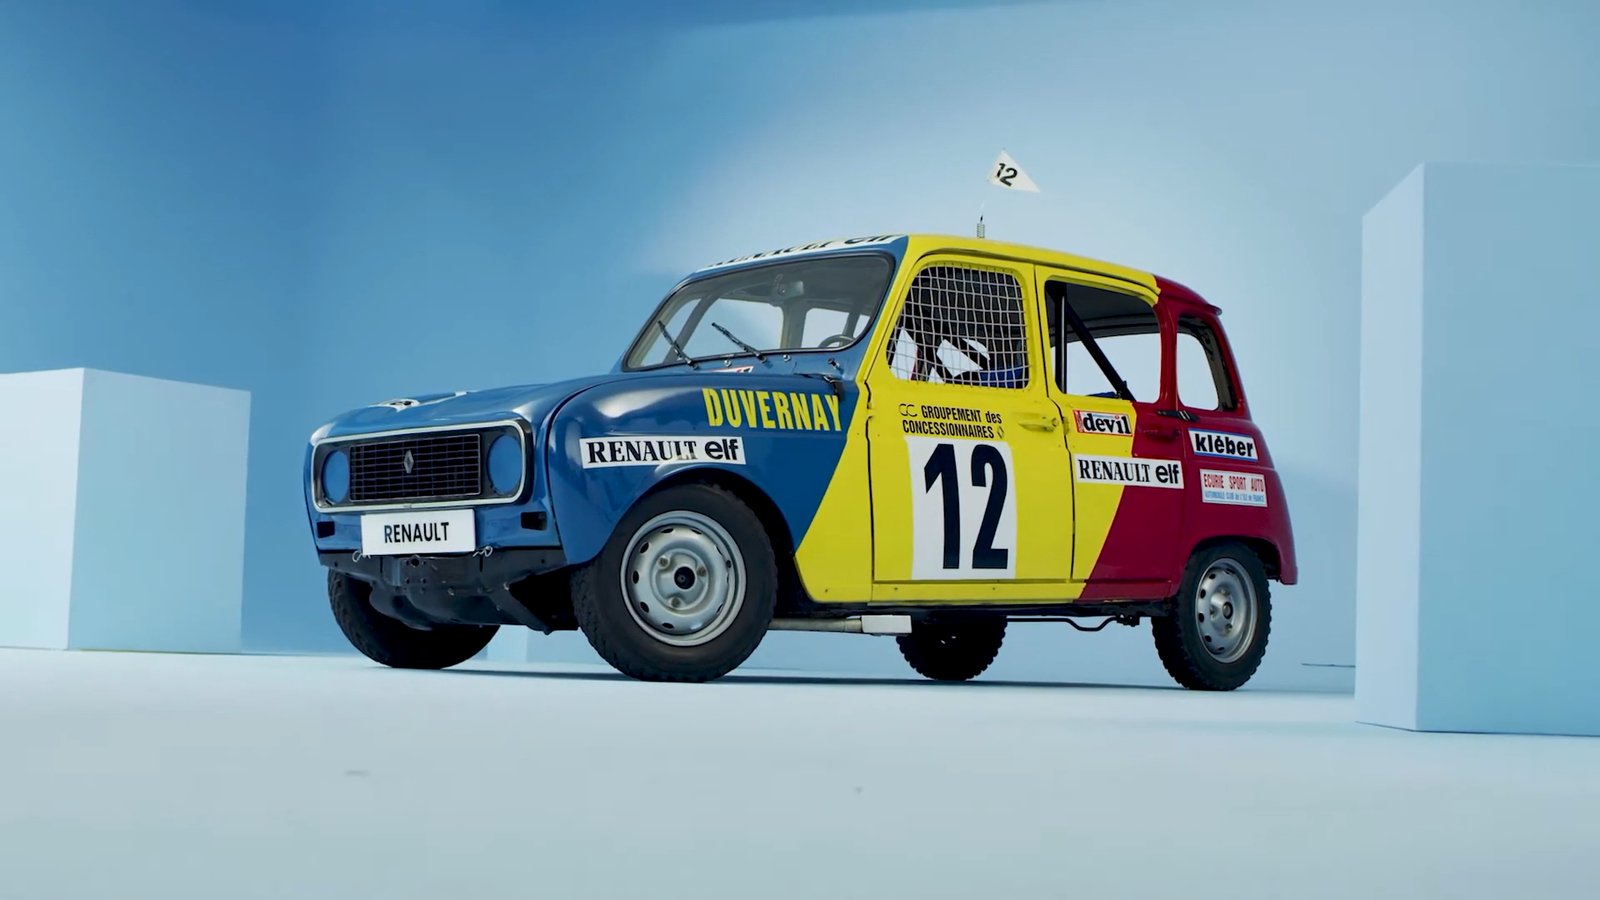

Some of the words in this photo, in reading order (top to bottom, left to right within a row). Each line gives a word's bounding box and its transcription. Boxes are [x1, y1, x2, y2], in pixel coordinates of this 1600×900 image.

[996, 162, 1018, 187] 12
[702, 388, 842, 432] DUVERNAY
[921, 405, 982, 423] GROUPEMENT
[985, 411, 1002, 424] des
[902, 419, 995, 439] CONCESSIONNAIRES
[1082, 413, 1131, 434] devil
[587, 440, 697, 464] RENAULT
[704, 438, 739, 460] elf
[1078, 459, 1150, 482] RENAULT
[1155, 464, 1180, 484] elf
[1204, 474, 1224, 489] ECURIE
[1229, 475, 1246, 490] SPORT
[1251, 477, 1264, 492] AUTO
[924, 443, 1008, 569] 12
[384, 521, 449, 544] RENAULT
